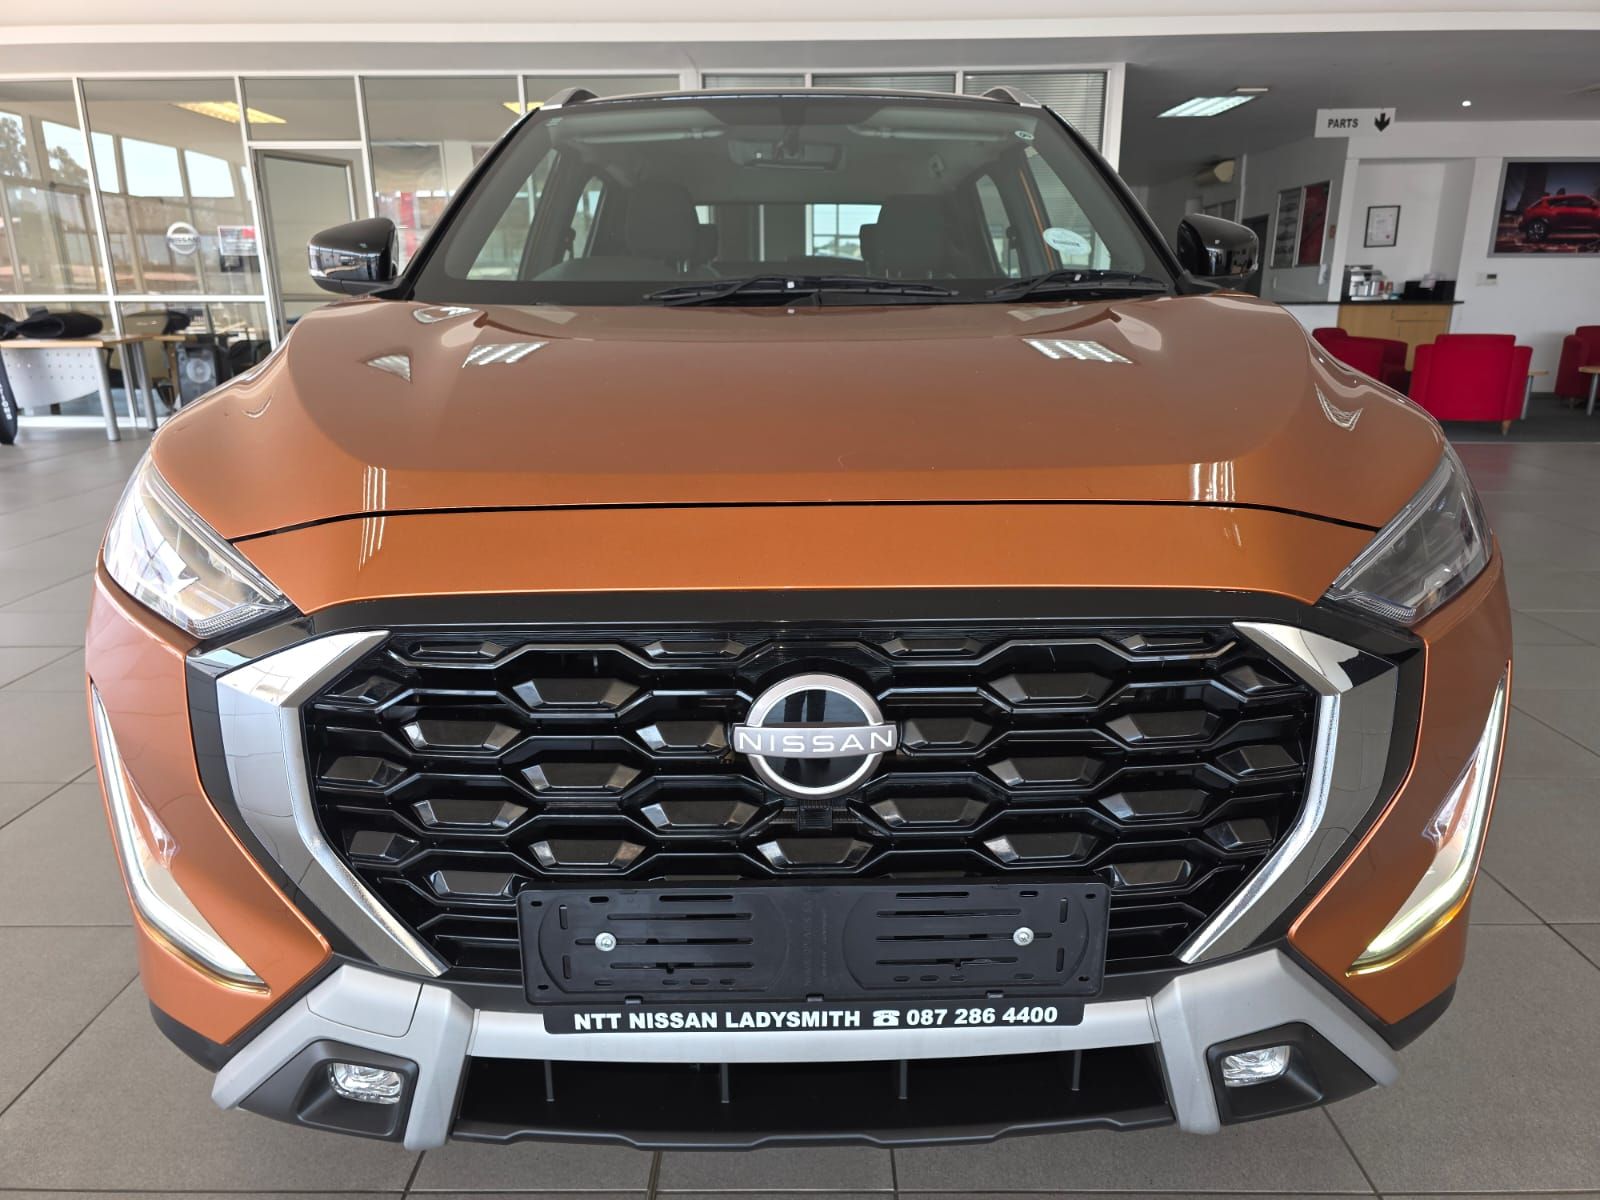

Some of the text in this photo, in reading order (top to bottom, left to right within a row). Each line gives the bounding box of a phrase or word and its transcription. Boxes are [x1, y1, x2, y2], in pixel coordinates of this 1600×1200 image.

[1327, 118, 1359, 129] PARTS
[739, 730, 892, 752] NISSAN
[574, 1006, 1058, 1030] NTT NISSAN LADYSMITH 087 286 4400
